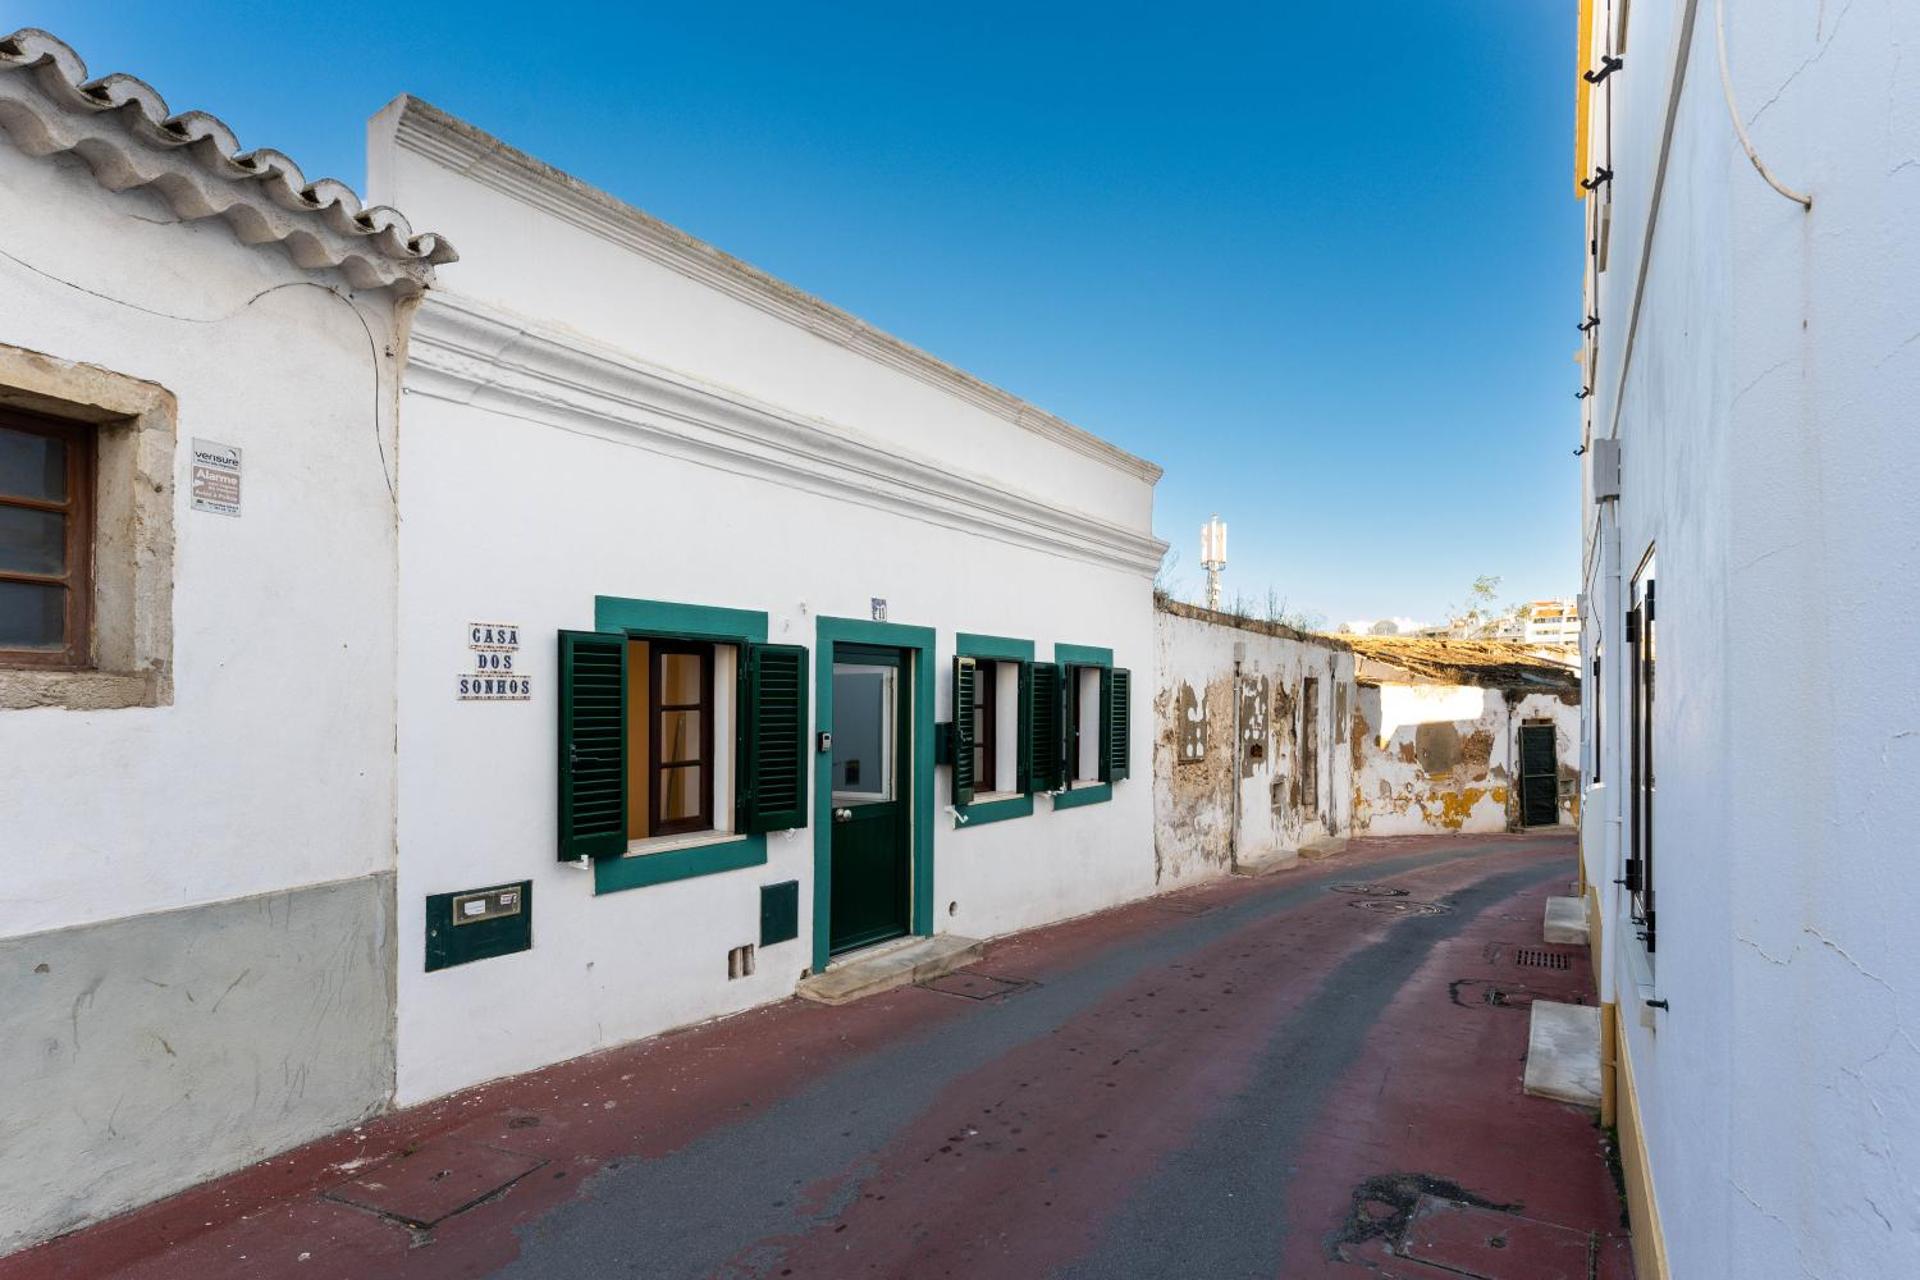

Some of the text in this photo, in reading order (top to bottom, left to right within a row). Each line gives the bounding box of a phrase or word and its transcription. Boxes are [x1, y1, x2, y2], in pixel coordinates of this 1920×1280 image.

[195, 451, 239, 466] verisure
[196, 469, 238, 485] Alarme
[472, 628, 518, 644] CASA
[478, 654, 512, 669] DOS
[460, 679, 529, 694] SONHOS
